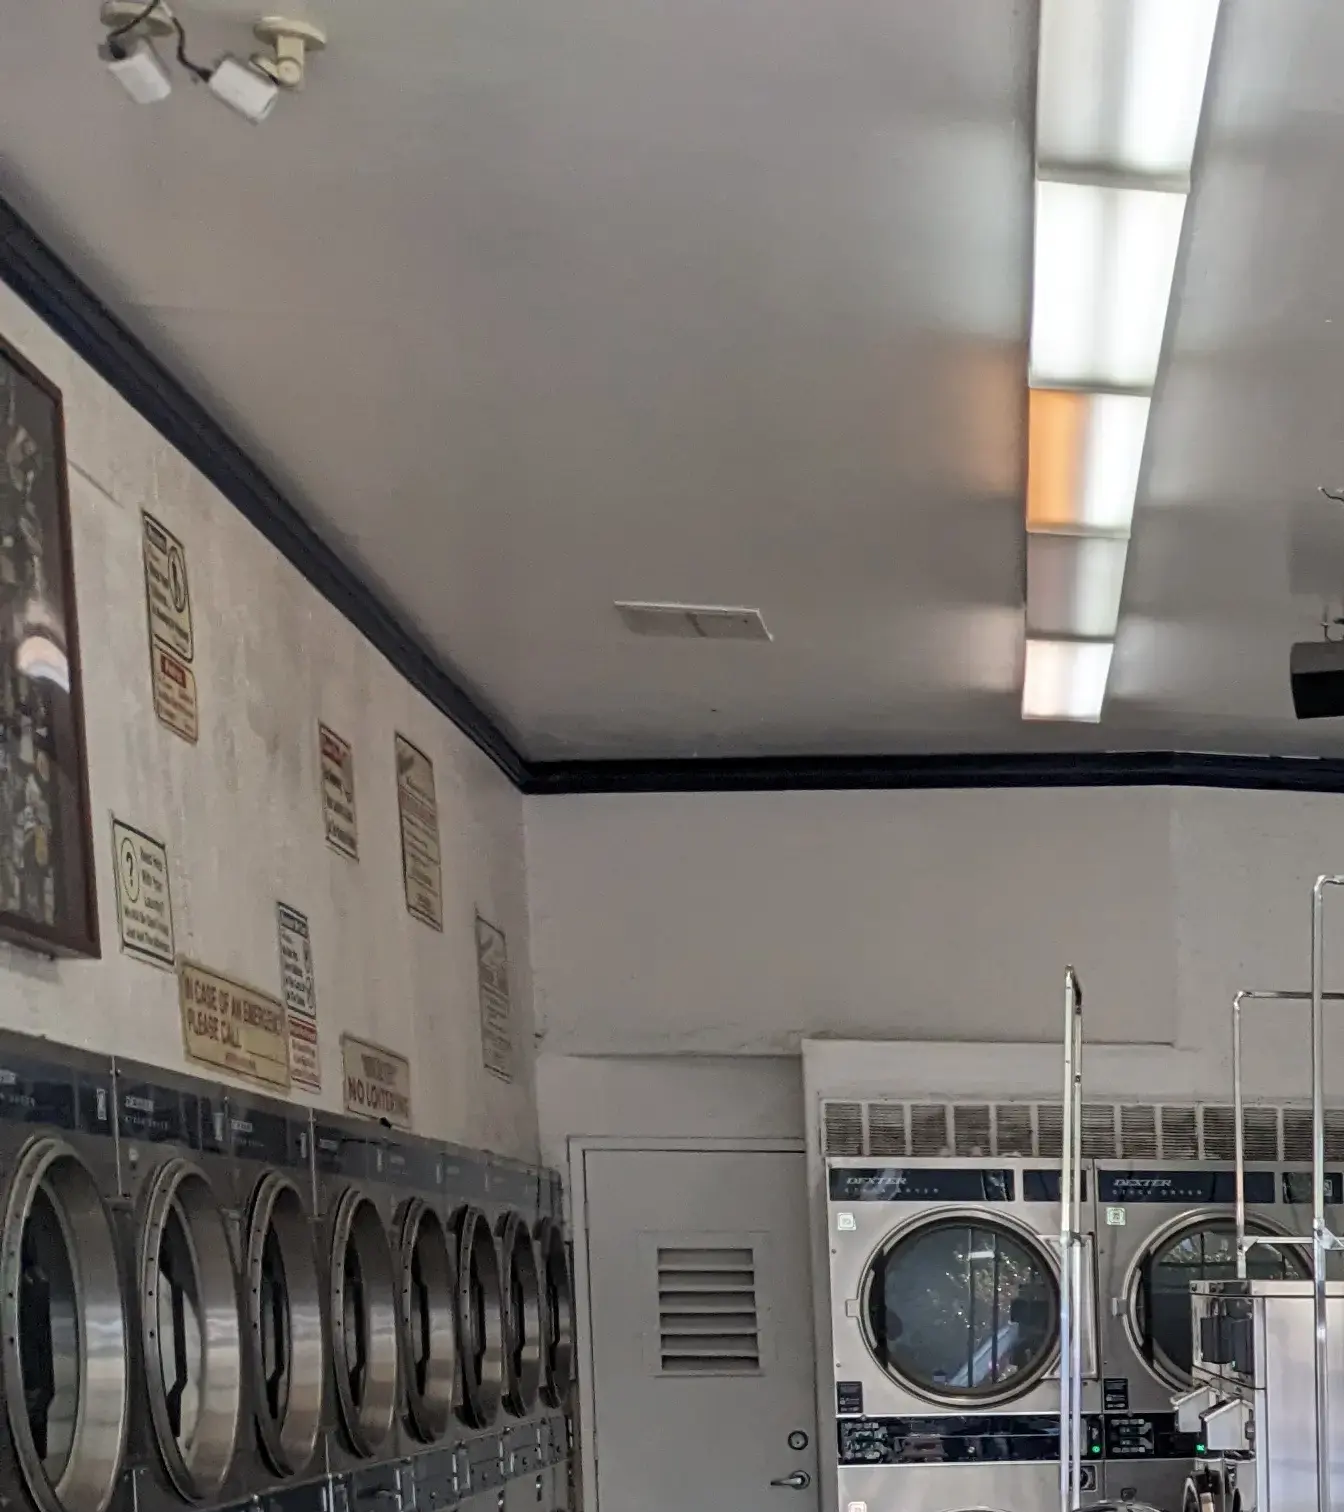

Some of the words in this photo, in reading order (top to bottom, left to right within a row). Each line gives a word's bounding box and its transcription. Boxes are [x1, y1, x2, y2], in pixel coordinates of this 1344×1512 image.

[194, 980, 217, 1012] CASE
[219, 991, 229, 1013] OF
[231, 996, 242, 1019] AN
[187, 1008, 219, 1040] PLEASE
[220, 1019, 242, 1049] CALL
[348, 1077, 364, 1101] NO
[846, 1177, 907, 1185] DEXTER
[1113, 1179, 1172, 1187] DEXTER
